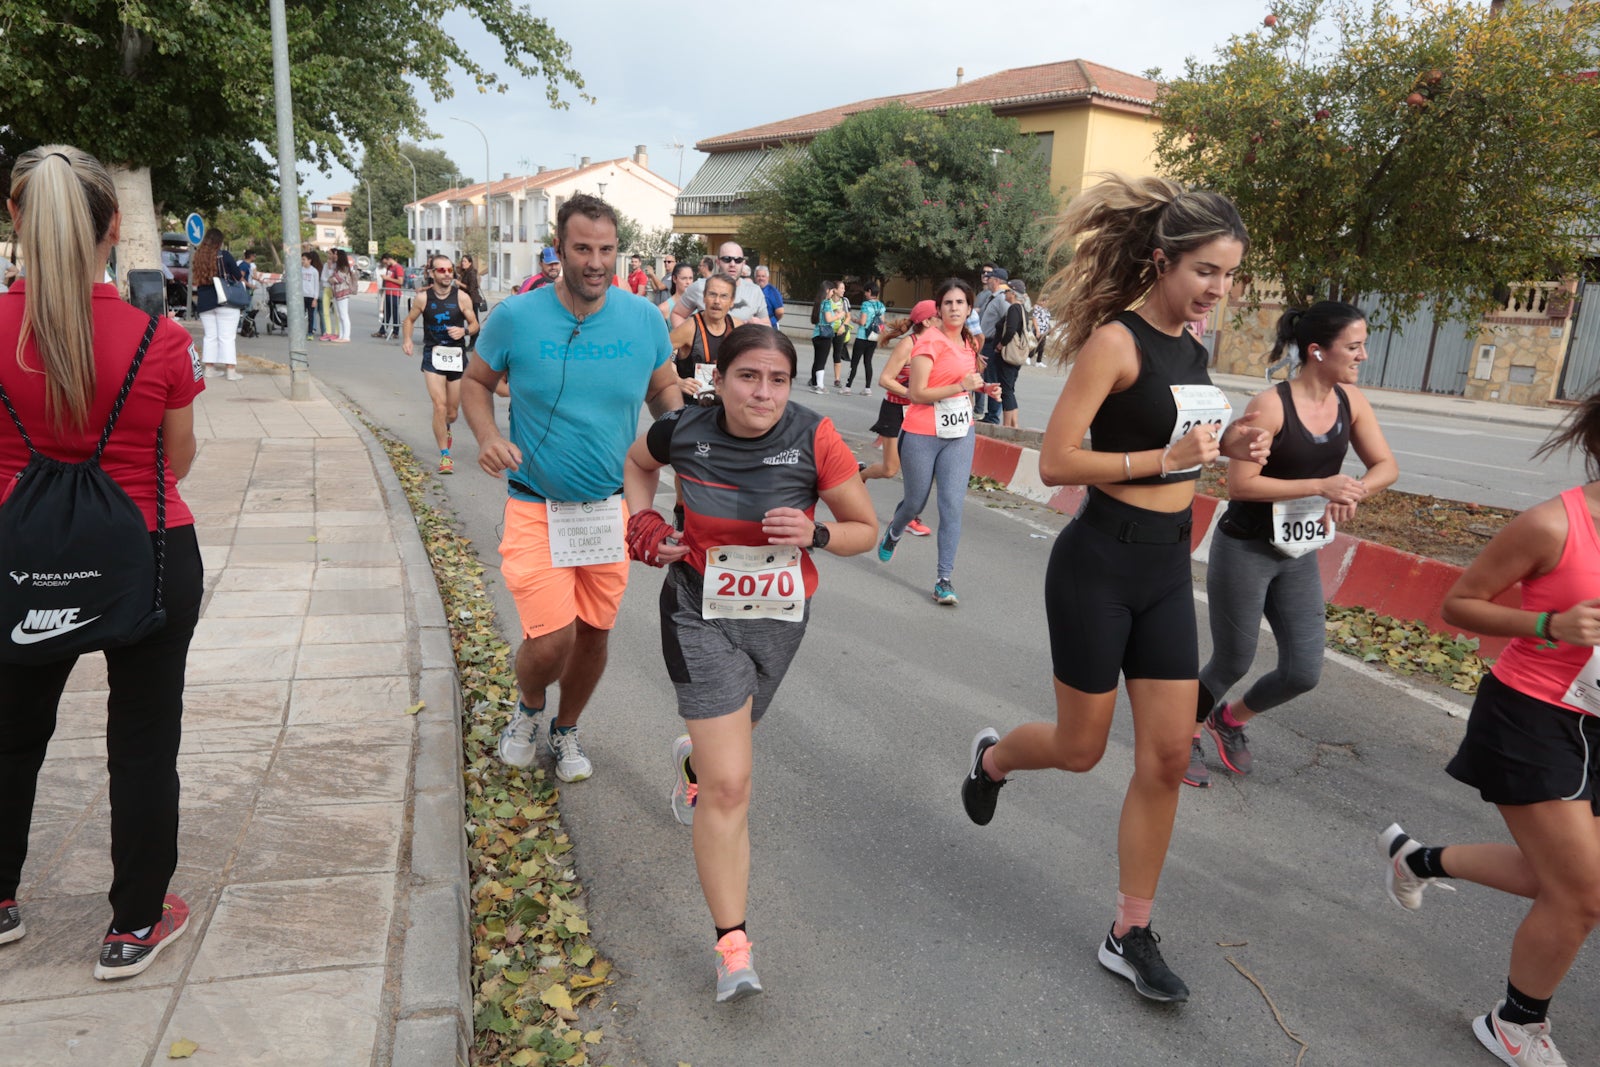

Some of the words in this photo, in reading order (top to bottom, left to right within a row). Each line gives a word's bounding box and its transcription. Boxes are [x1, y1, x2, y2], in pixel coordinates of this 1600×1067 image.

[540, 340, 633, 361] Reebok
[941, 411, 970, 427] 3041
[557, 527, 566, 537] YO
[567, 526, 588, 537] CORRO
[589, 524, 612, 535] CONTRA
[1281, 520, 1327, 543] 3094
[569, 538, 577, 548] EL
[32, 572, 62, 581] RAFA
[63, 570, 102, 580] NADAL
[717, 571, 795, 597] 2070
[22, 608, 81, 630] NIKE
